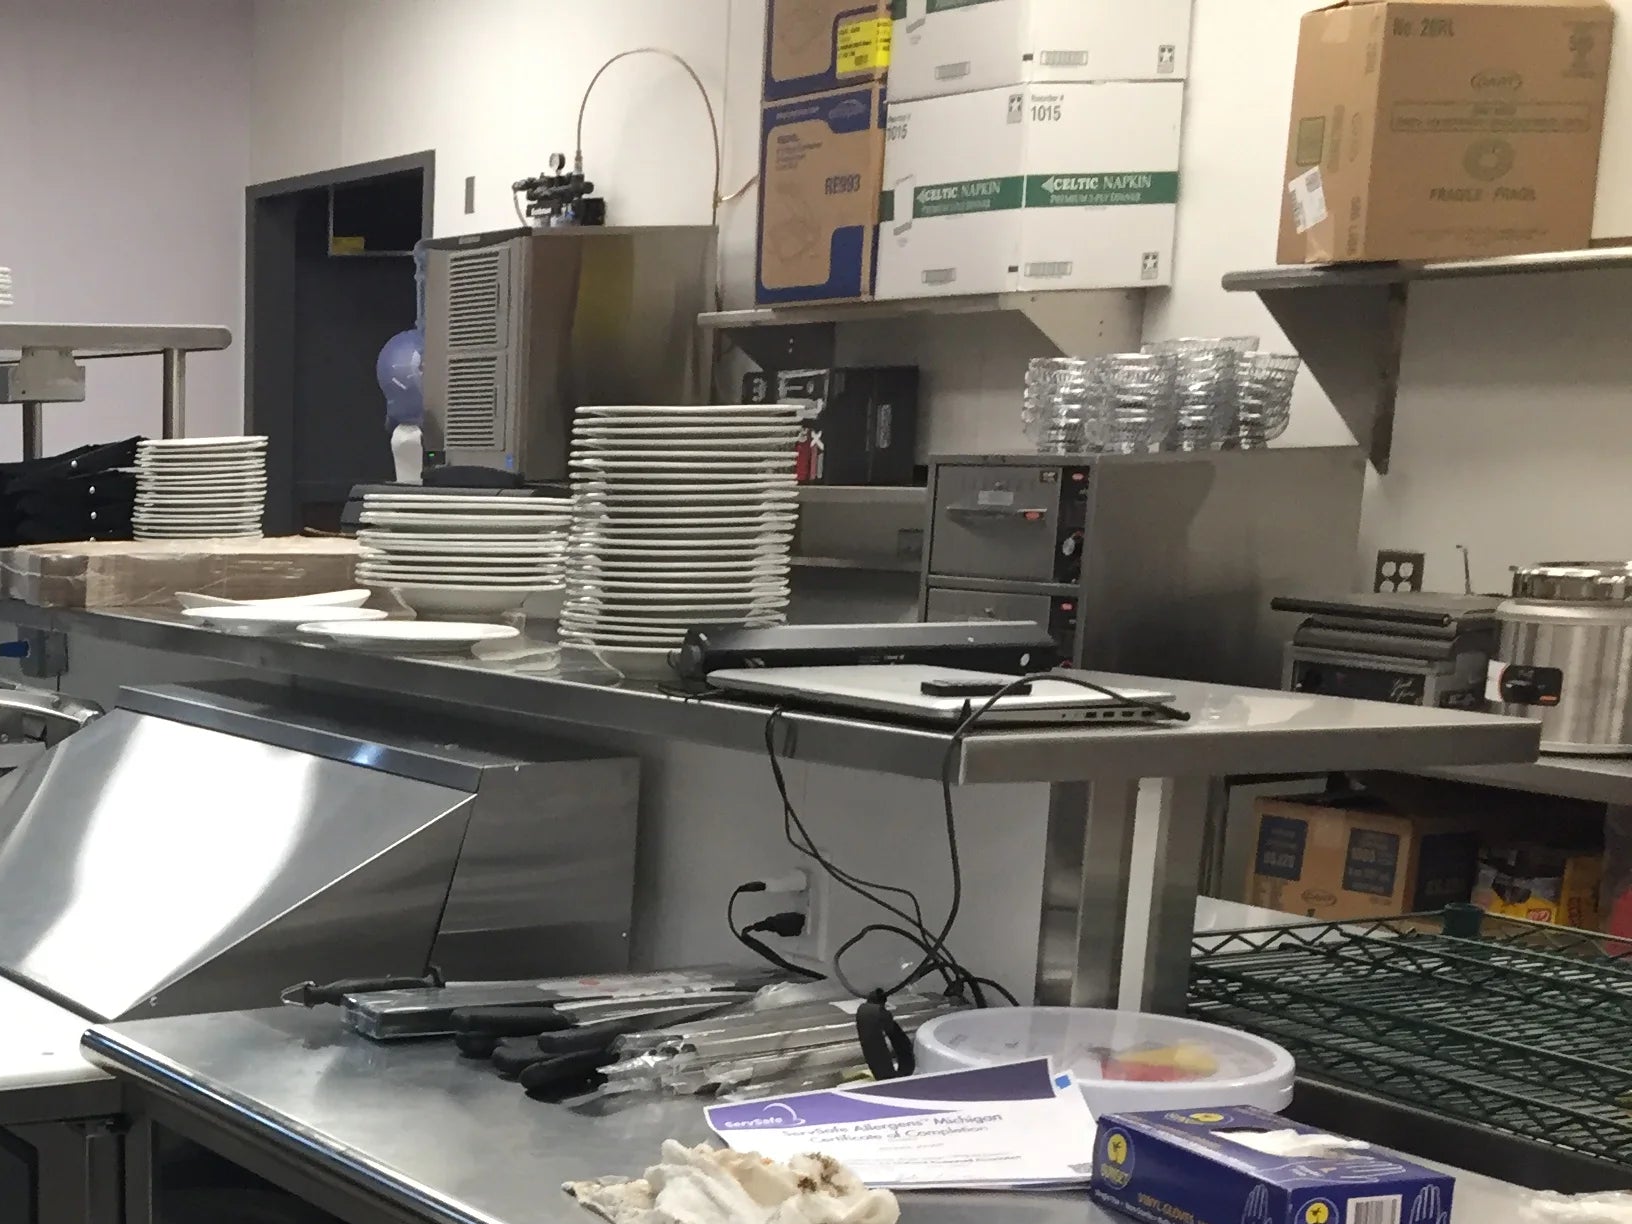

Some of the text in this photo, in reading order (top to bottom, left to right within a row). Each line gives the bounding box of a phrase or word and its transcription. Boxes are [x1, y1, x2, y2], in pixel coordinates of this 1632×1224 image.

[1030, 104, 1062, 122] 1015
[926, 180, 1001, 202] CELTIC NAPKIN
[1053, 174, 1153, 191] CELTIC NAPKIN
[934, 1113, 1003, 1129] Michigan
[809, 1125, 989, 1143] Certificate of Completion
